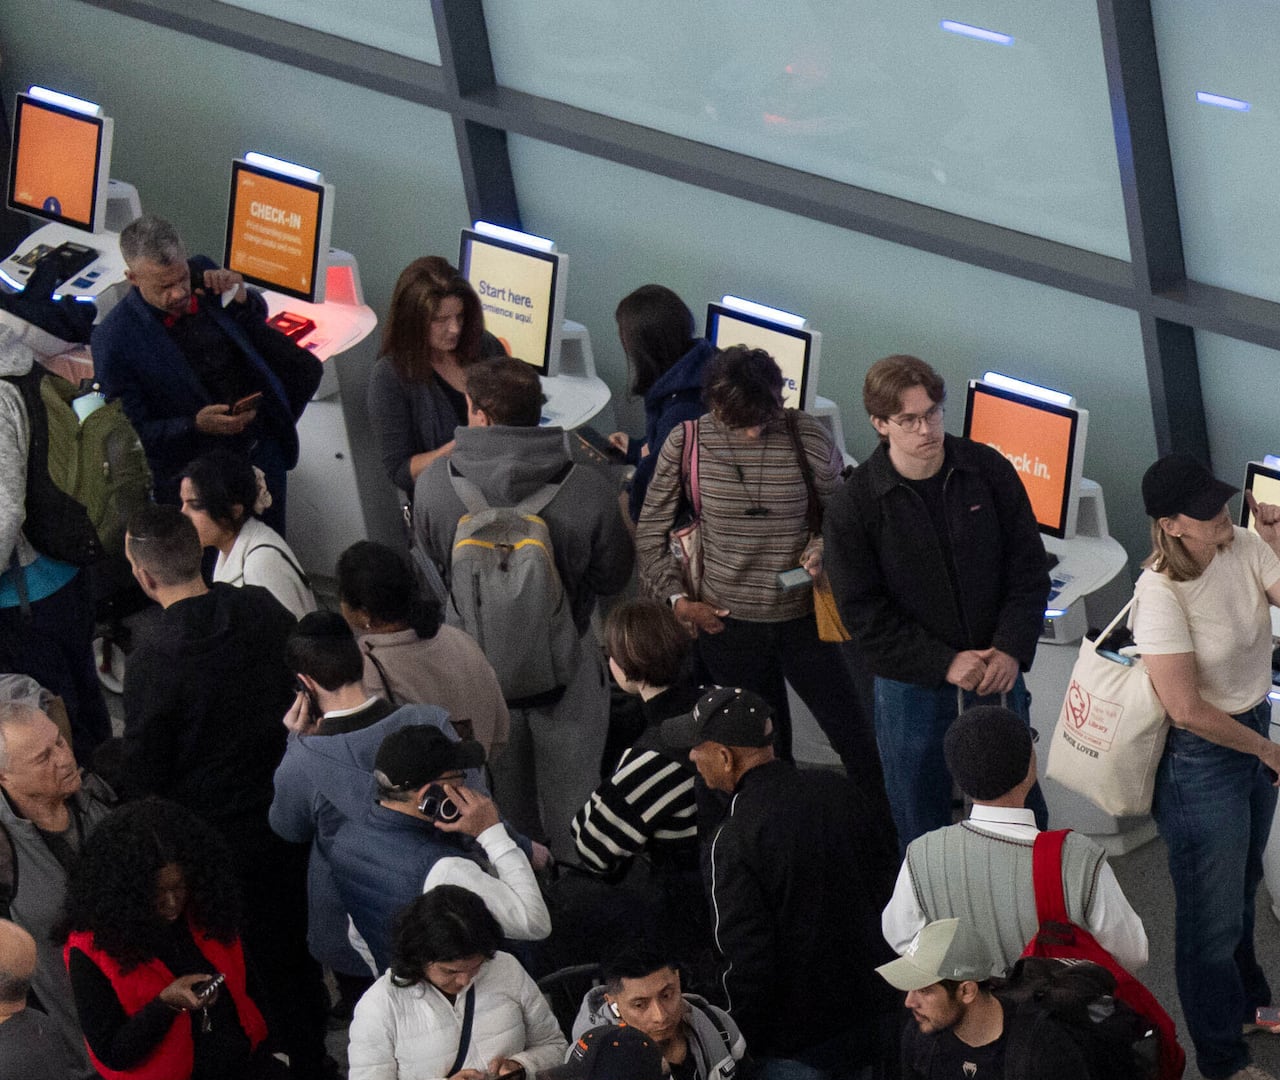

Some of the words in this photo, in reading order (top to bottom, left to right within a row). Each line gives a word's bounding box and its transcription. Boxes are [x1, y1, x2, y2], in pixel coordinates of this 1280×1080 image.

[251, 201, 301, 229] CHECK-IN
[479, 280, 506, 301] Start
[508, 288, 533, 308] here.
[481, 303, 513, 318] omience
[1033, 456, 1051, 480] in.
[1077, 743, 1099, 759] LOVER
